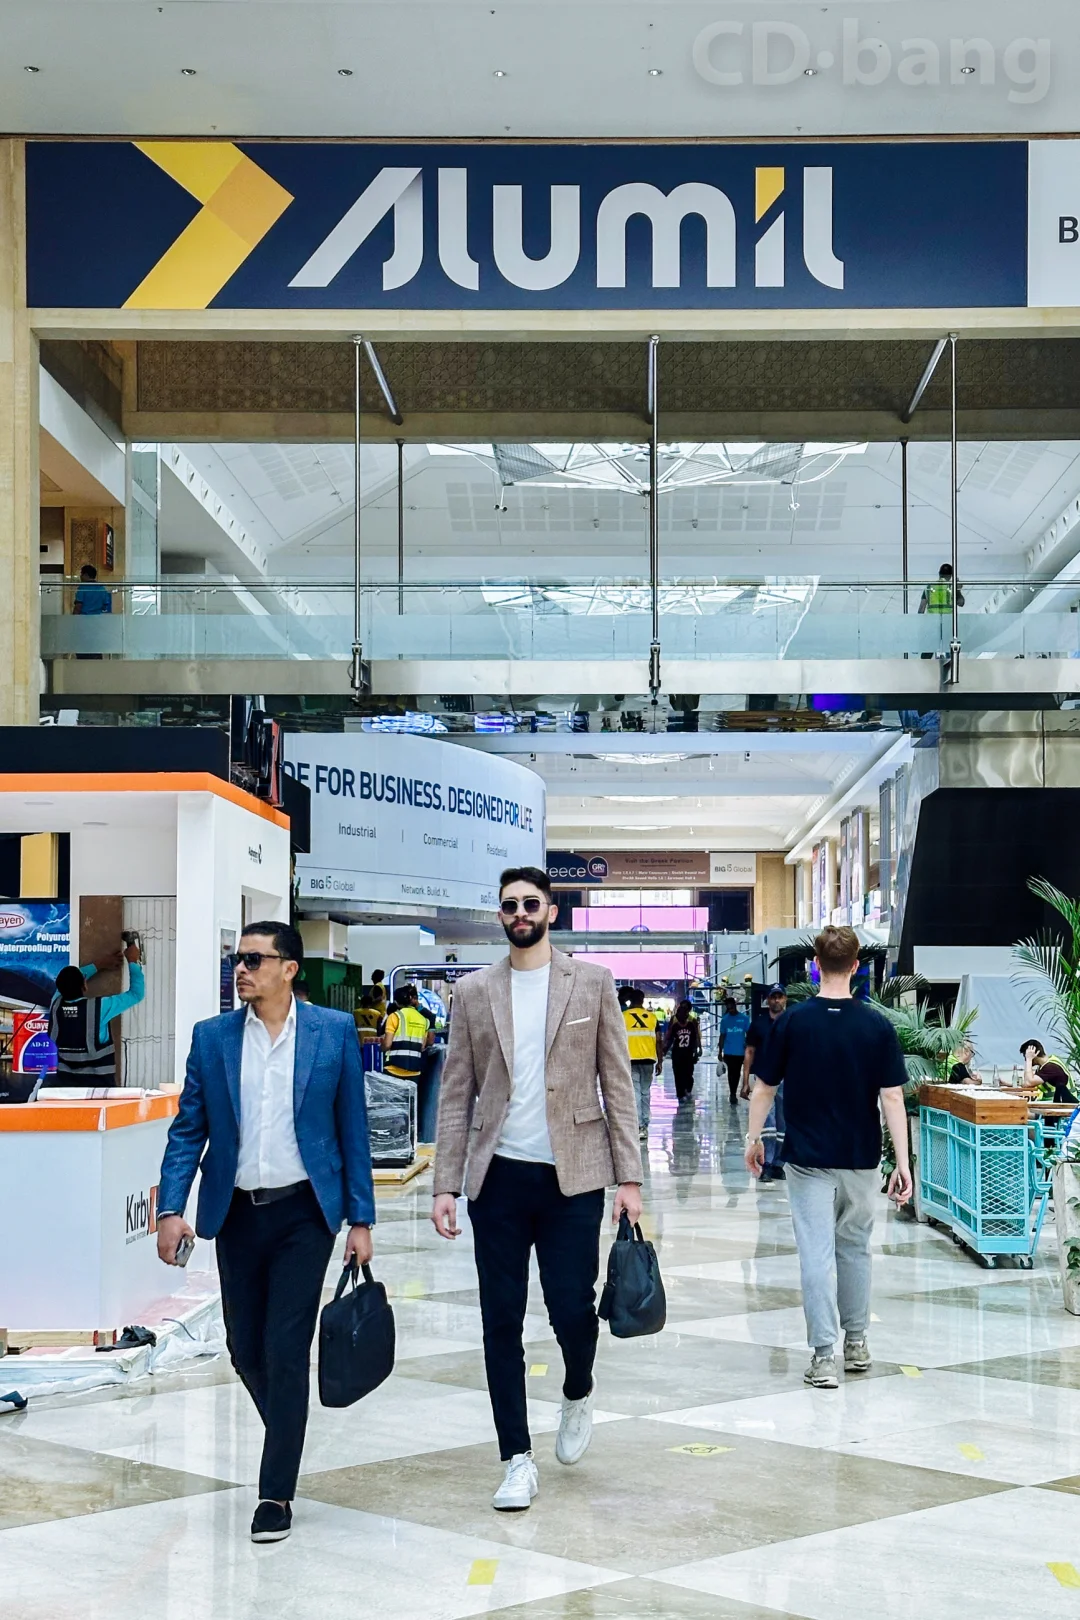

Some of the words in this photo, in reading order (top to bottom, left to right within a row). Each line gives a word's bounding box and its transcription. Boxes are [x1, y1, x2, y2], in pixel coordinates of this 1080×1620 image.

[288, 165, 845, 291] Alumil
[316, 765, 355, 798] FOR
[360, 772, 446, 812] BUSINESS.
[449, 786, 503, 822] DESIGNED
[504, 800, 520, 828] FOR
[339, 822, 377, 839] Industrial
[423, 833, 458, 849] Commercial
[487, 843, 508, 858] Residential
[311, 879, 325, 889] BIG
[333, 880, 355, 892] Global
[401, 884, 425, 896] Network.
[678, 1034, 690, 1048] 23
